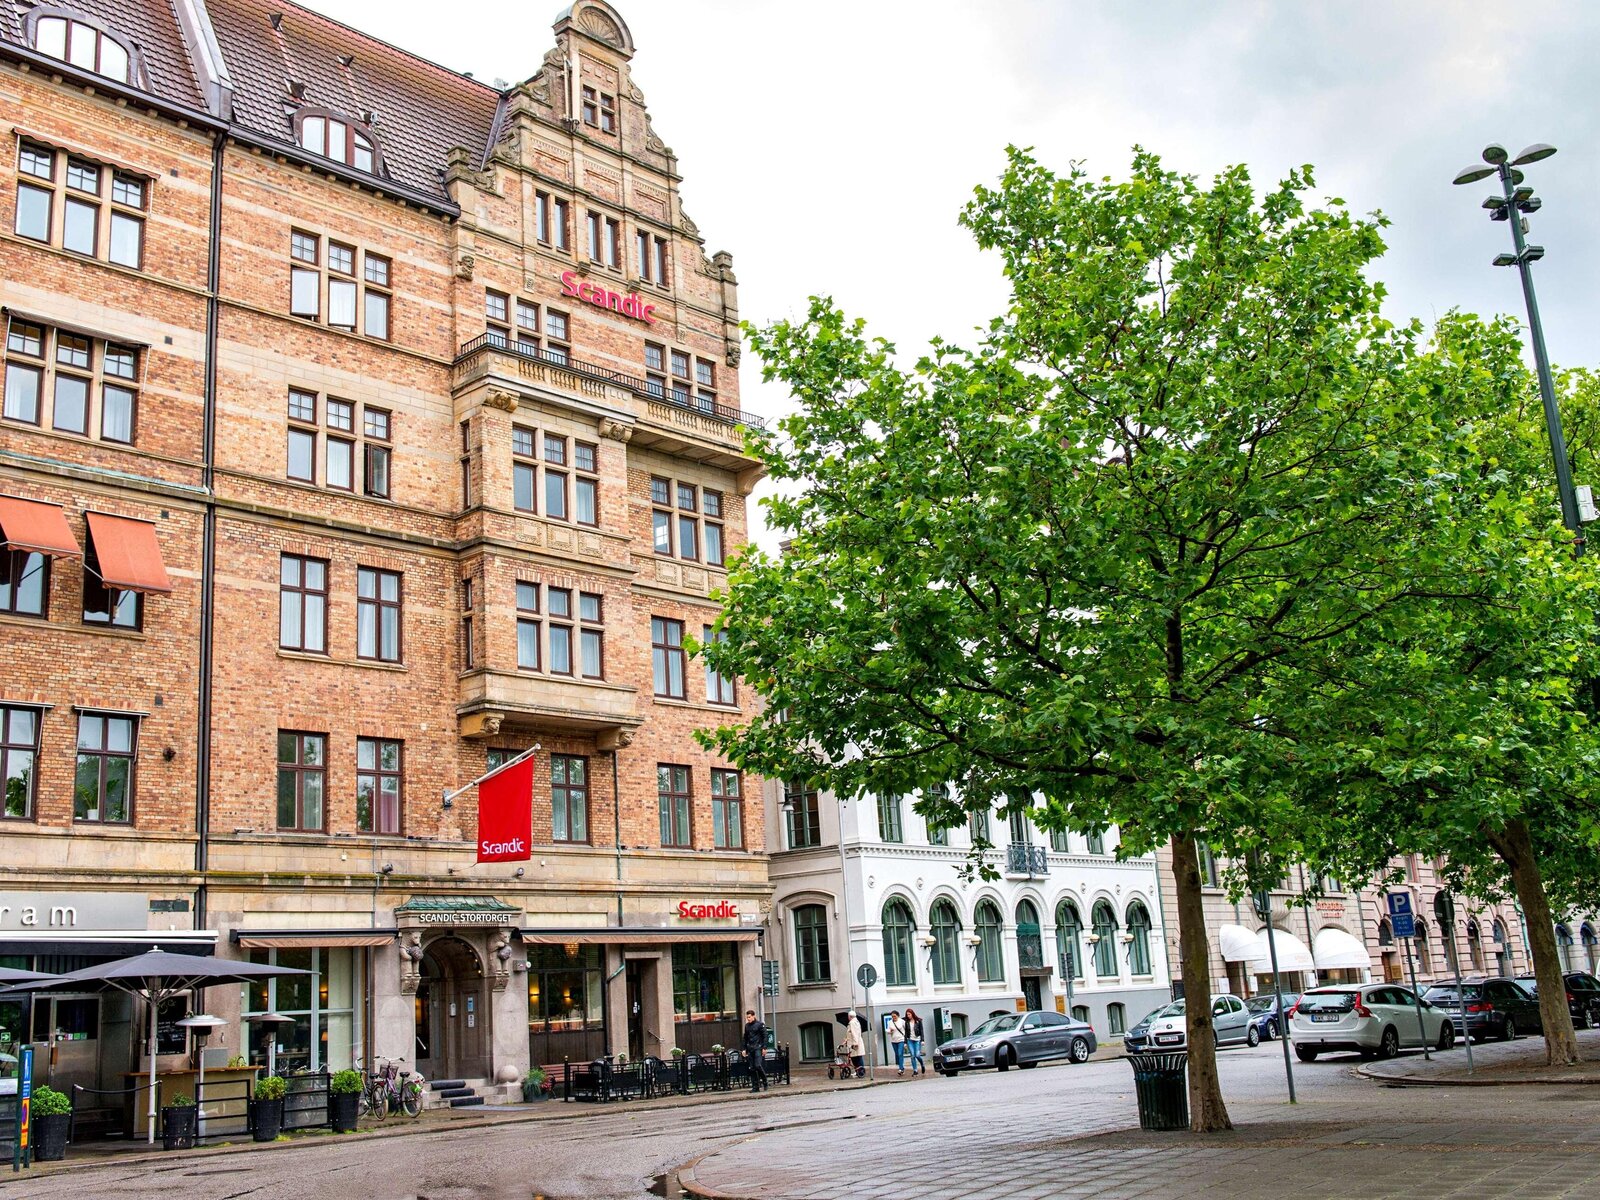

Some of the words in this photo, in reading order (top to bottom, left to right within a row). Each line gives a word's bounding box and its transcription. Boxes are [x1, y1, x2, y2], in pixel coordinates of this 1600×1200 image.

[561, 271, 656, 324] Scandic
[482, 837, 525, 854] Scandic
[679, 900, 738, 918] Scandic
[1393, 895, 1406, 912] P
[418, 913, 456, 922] SCANDIC
[459, 913, 512, 922] STORTORGET
